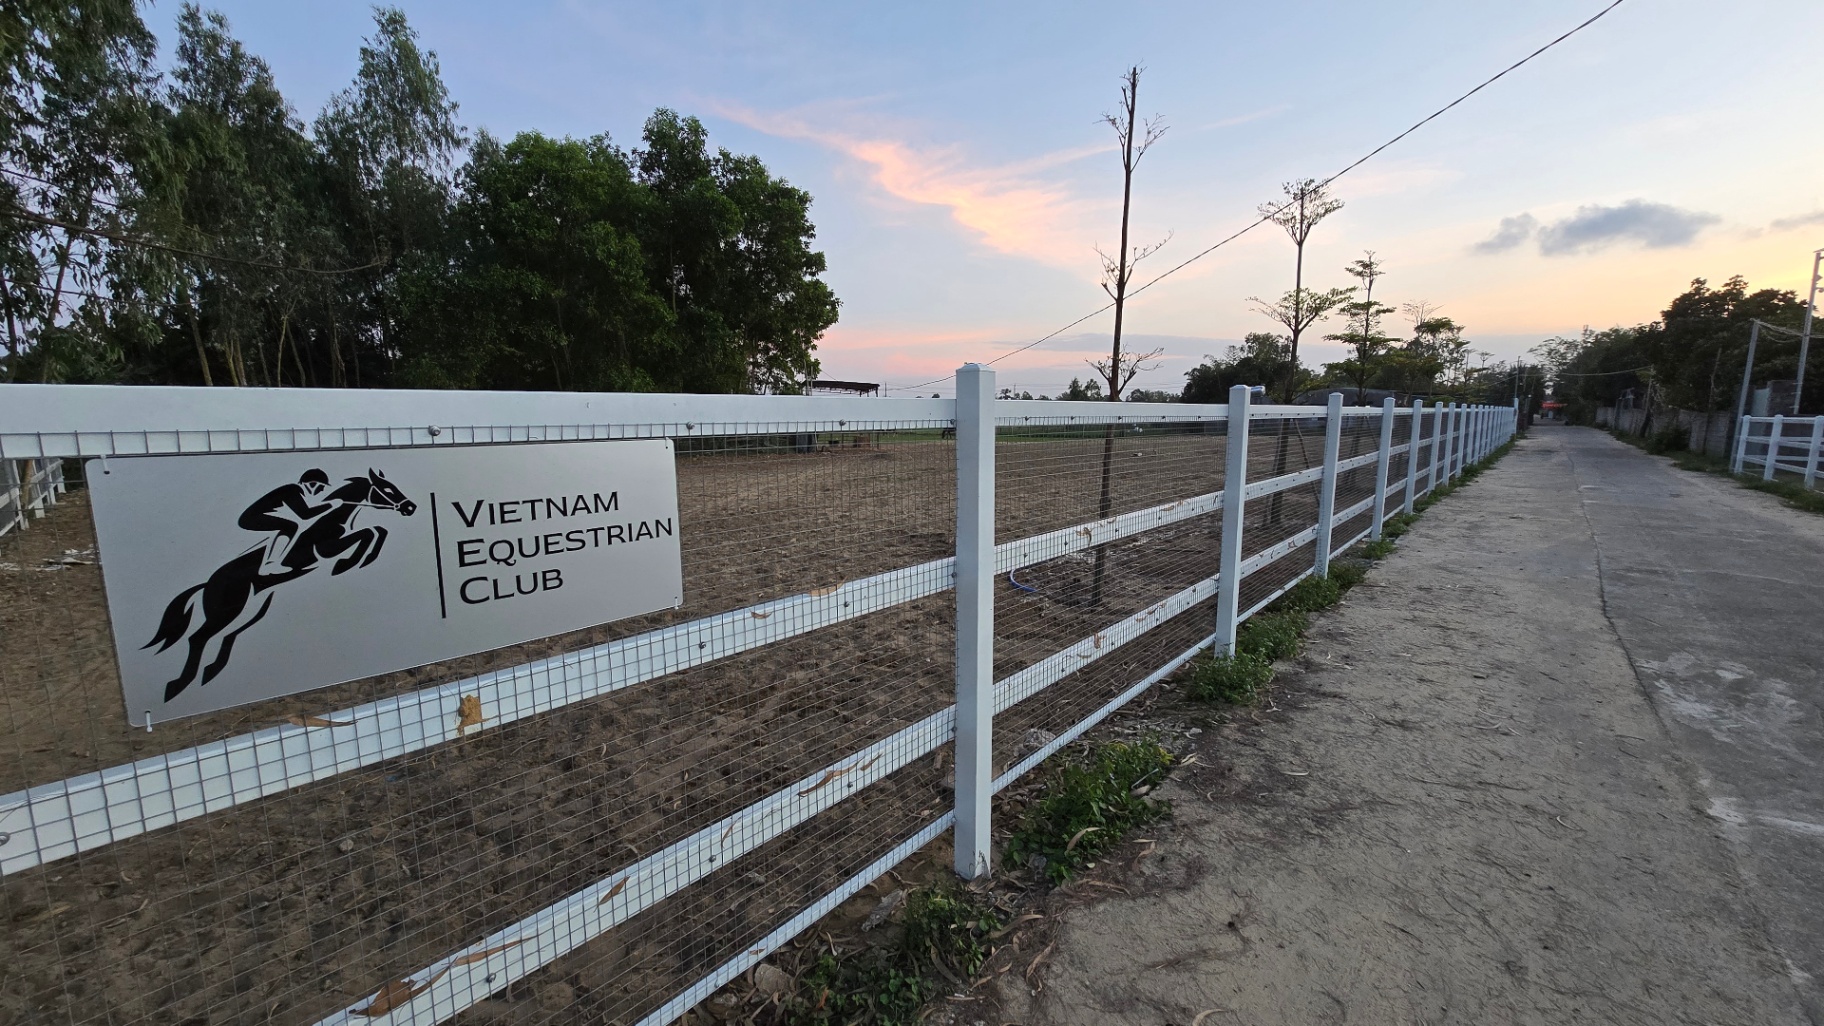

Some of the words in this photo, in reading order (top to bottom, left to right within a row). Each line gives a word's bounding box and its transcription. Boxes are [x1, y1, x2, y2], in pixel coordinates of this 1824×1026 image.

[452, 491, 619, 528] VIETNAM
[457, 517, 673, 568] EQUESTRIAN
[459, 568, 564, 605] CLUB
